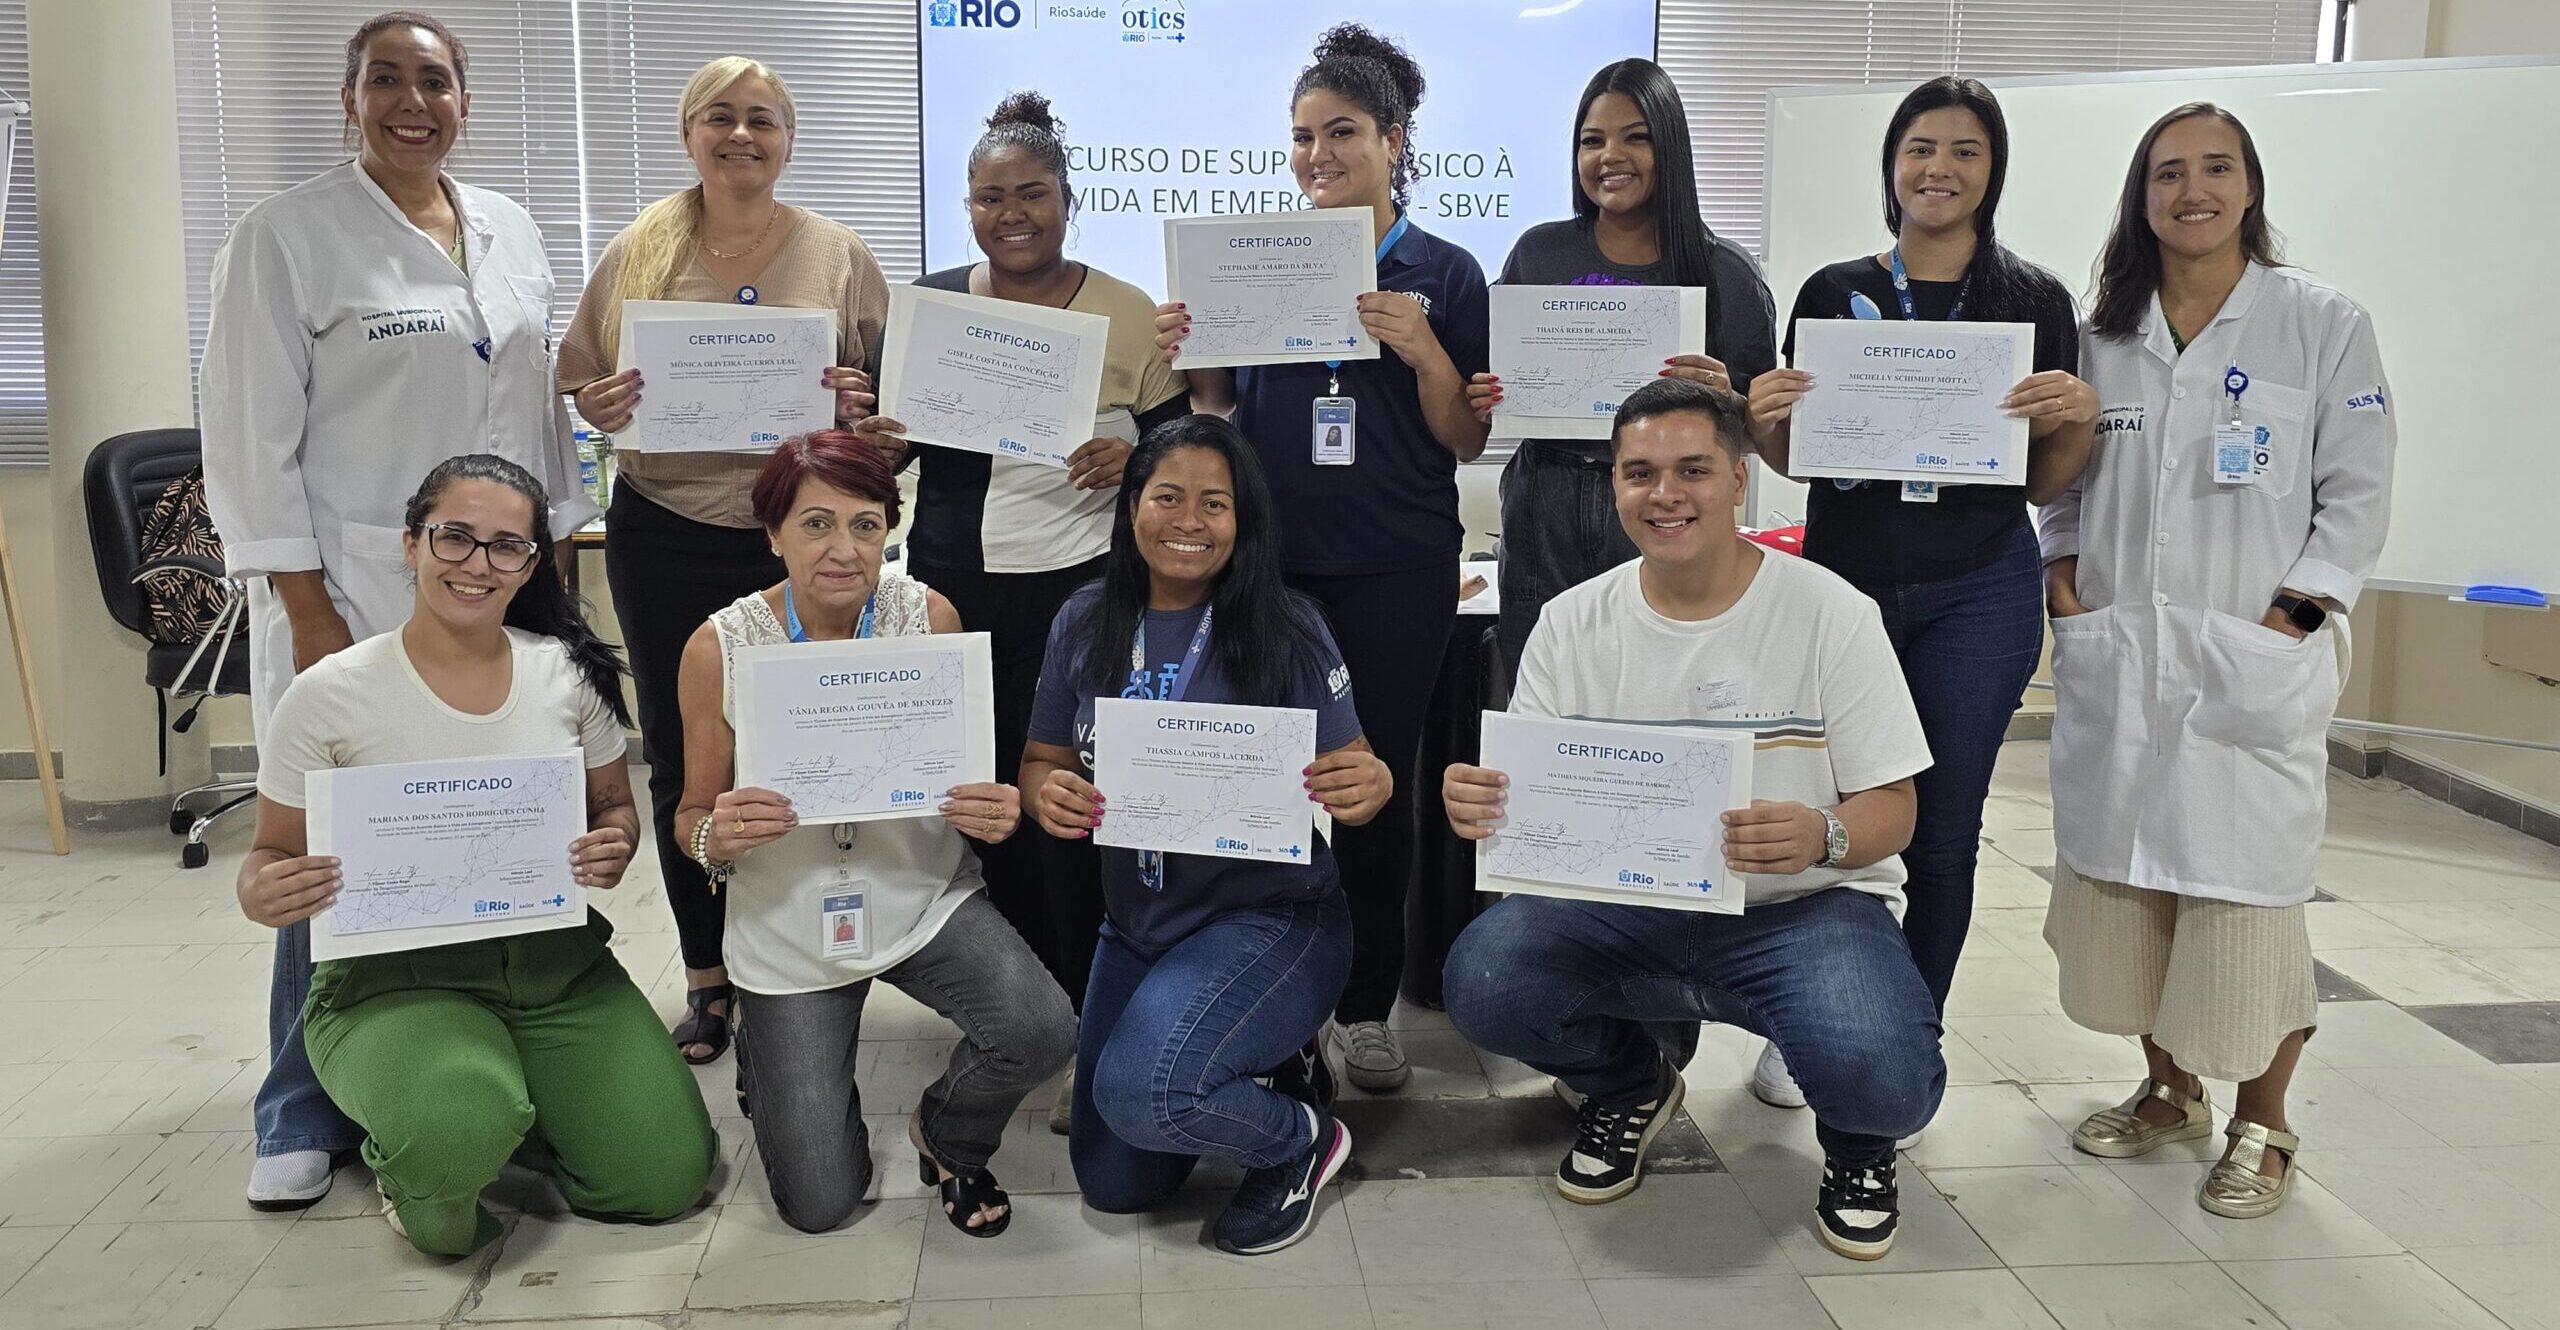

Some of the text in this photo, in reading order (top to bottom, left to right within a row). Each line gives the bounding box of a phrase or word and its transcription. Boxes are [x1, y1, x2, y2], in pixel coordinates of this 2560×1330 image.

[960, 0, 1021, 28] RIO
[1049, 6, 1106, 18] RioSaúde
[1122, 7, 1185, 30] otics
[1130, 34, 1145, 42] RIO
[1067, 146, 1514, 178] CURSO DE SUP SICO À
[1154, 189, 1197, 213] EM
[1211, 190, 1313, 214] EMERG
[1438, 193, 1510, 218] SBVE
[1229, 236, 1312, 248] CERTIFICADO
[1302, 262, 1324, 270] SILVA
[1542, 300, 1626, 312] CERTIFICADO
[362, 311, 395, 321] HOSPITAL
[368, 316, 446, 341] ANDARAÍ
[1536, 325, 1565, 334] THAINÁ
[1596, 327, 1632, 335] ALMEIDA
[689, 333, 776, 345] CERTIFICADO
[966, 325, 1051, 354] CERTIFICADO
[1296, 338, 1313, 346] Rio
[1863, 346, 1956, 360] CERTIFICADO
[670, 359, 702, 368] MÔNICA
[704, 360, 741, 368] OLIVEIRA
[777, 358, 797, 366] LEAL
[947, 348, 1060, 380] GISELE COSTA DA CONCEIÇÃO
[1849, 373, 1968, 385] MICHELLY SCHIMIDT MOTTA
[2347, 394, 2374, 409] SUS
[2103, 406, 2133, 415] MUNICIPAL
[2095, 414, 2145, 435] DARAÍ
[762, 433, 779, 441] Rio
[1010, 441, 1027, 453] Rio
[1929, 455, 1947, 465] Rio
[819, 669, 921, 687] CERTIFICADO
[788, 698, 954, 716] VÂNIA REGINA GOUVÊA DE MENEZES
[1157, 717, 1255, 735] CERTIFICADO
[1145, 746, 1265, 762] THASSIA CAMPOS LACERDA
[1557, 742, 1664, 764] CERTIFICADO
[403, 777, 513, 794] CERTIFICADO
[1547, 772, 1577, 781] MATHEUS
[1609, 778, 1634, 786] GUEDES
[904, 791, 925, 801] Rio
[368, 806, 546, 824] MARIANA DOS SANTOS RODRIGUES CUNHA
[1229, 840, 1249, 851] Rio
[1632, 872, 1654, 885] Rio
[489, 901, 510, 911] Rio
